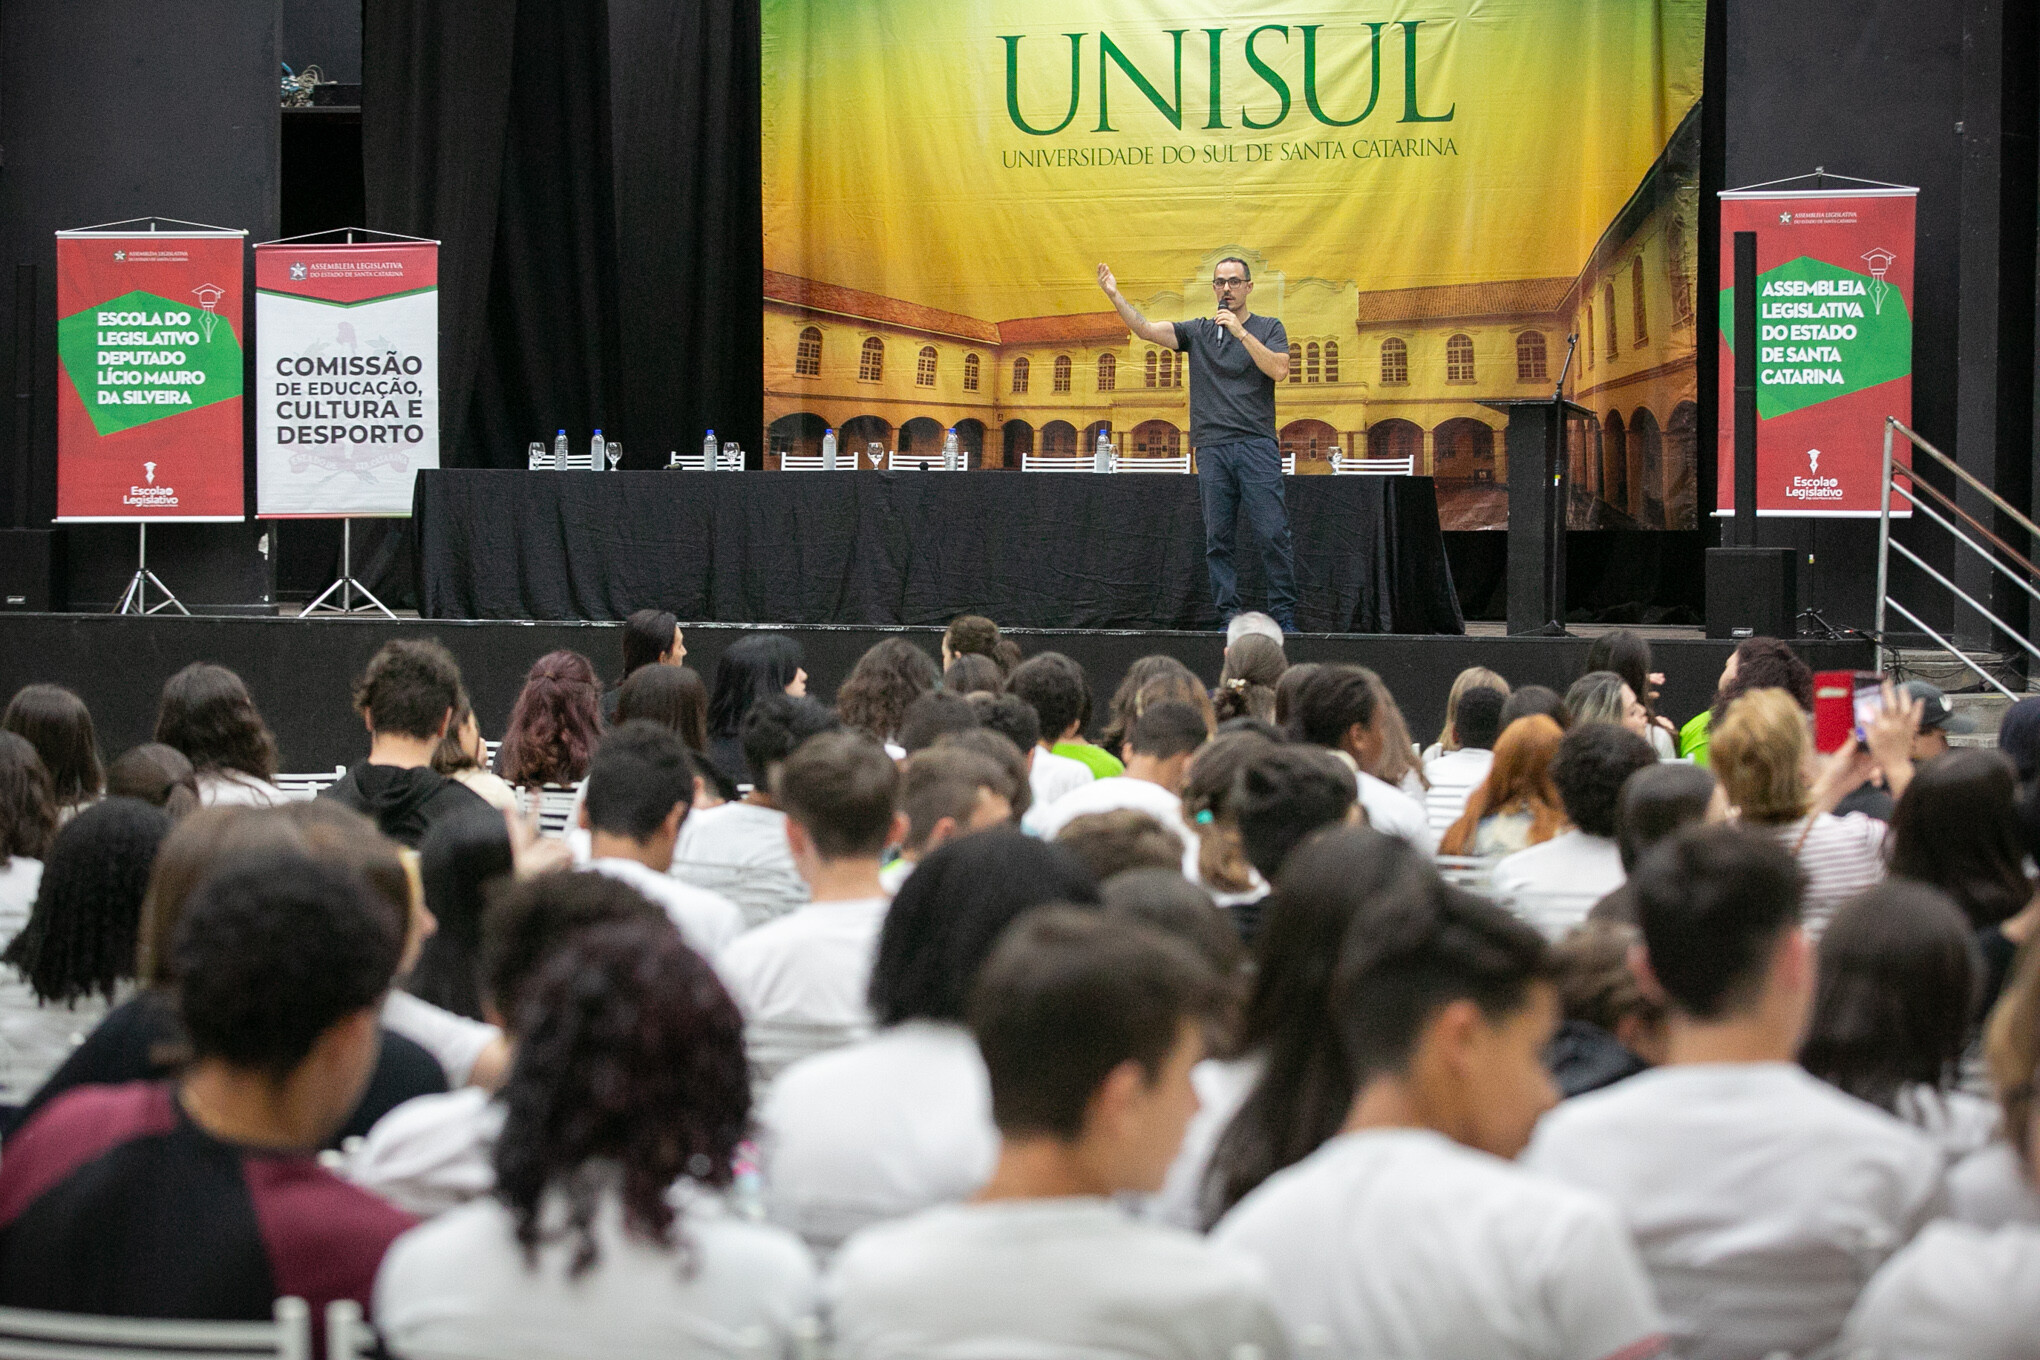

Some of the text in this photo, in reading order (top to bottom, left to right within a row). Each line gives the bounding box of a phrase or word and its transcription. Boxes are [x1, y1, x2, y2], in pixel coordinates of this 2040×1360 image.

[996, 20, 1456, 136] UNISUL
[1002, 138, 1459, 168] UNIVERSIDADE DO SUL DE SANTA CATARINA
[310, 262, 356, 270] ASSEMBLEIA
[1761, 280, 1866, 297] ASSEMBLEIA
[97, 312, 191, 326] ESCOLA DO
[1762, 302, 1865, 319] LEGISLATIVA
[97, 331, 200, 346] LEGISLATIVO
[1761, 324, 1857, 341] DO ESTADO
[97, 351, 186, 365] DEPUTADO
[1761, 346, 1842, 363] DE SANTA
[276, 350, 423, 377] COMISSÃO
[97, 367, 206, 385] LÍCIO MAURO
[1760, 368, 1845, 385] CATARINA
[276, 377, 423, 399] DE EDUCAÇÃO,
[97, 390, 192, 405] DA SILVEIRA
[276, 399, 423, 419] CULTURA E
[277, 424, 424, 445] DESPORTO
[1793, 475, 1830, 487] Escola
[130, 485, 166, 496] Escola
[1785, 486, 1843, 500] Legislativo
[123, 495, 179, 507] Legislativo
